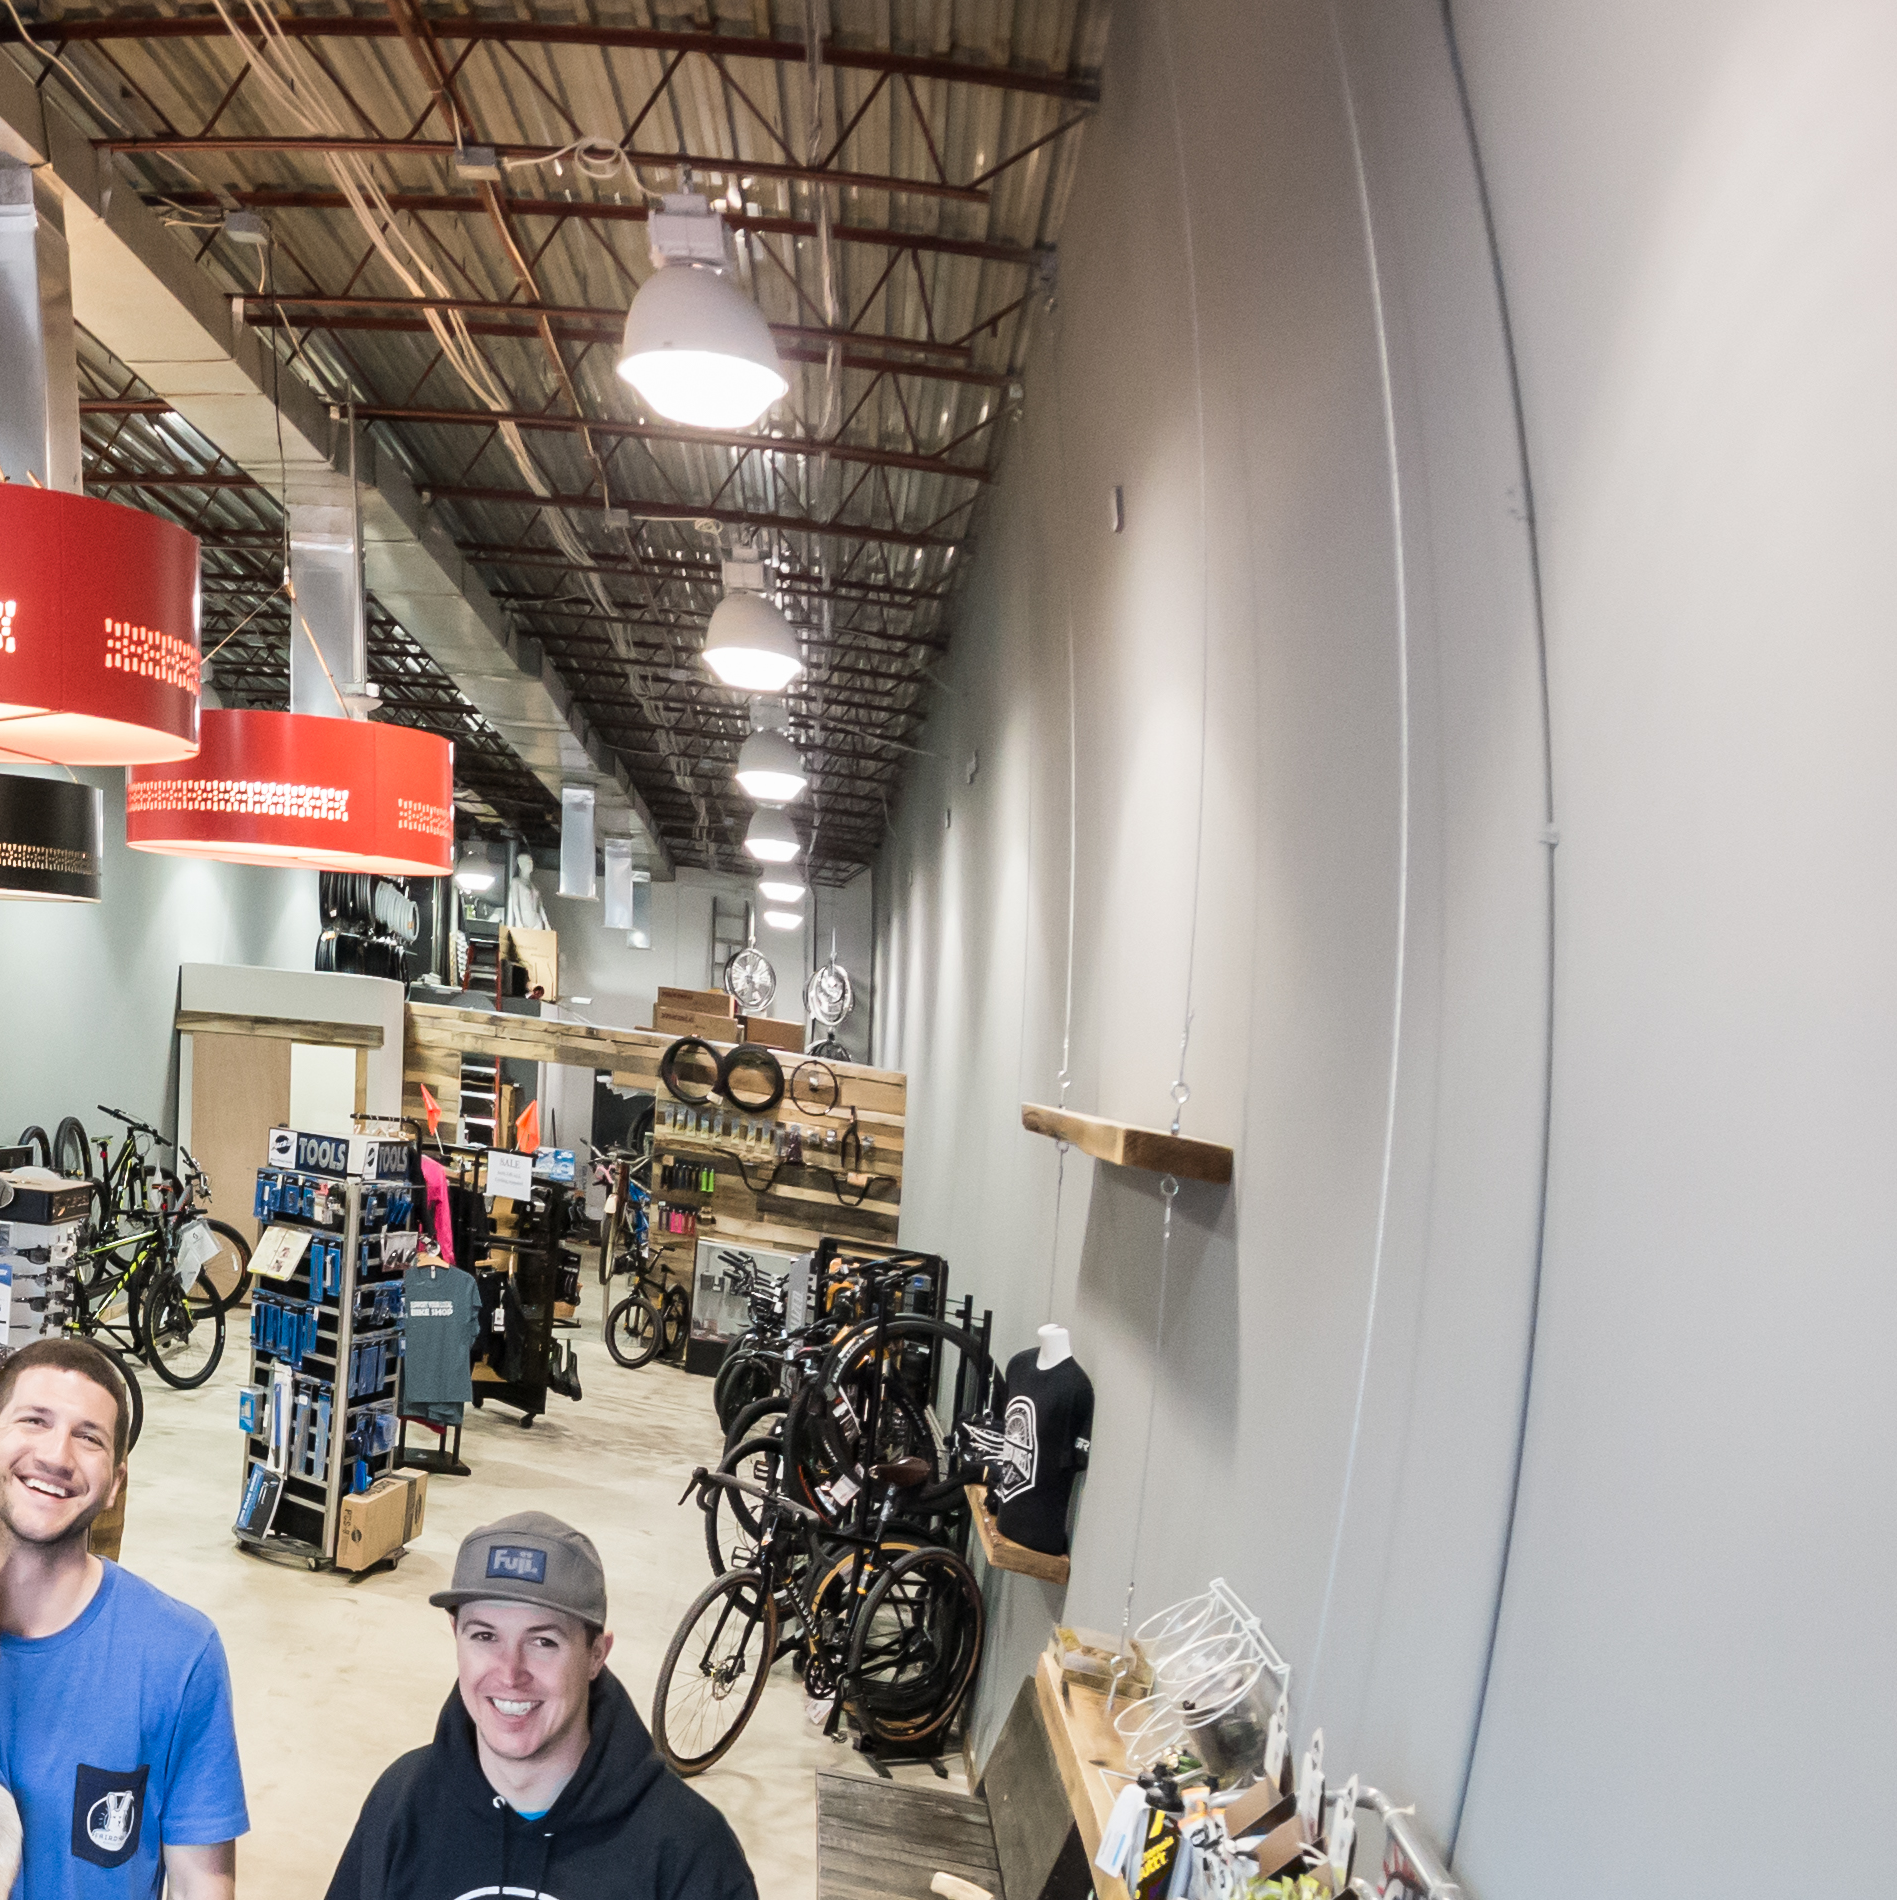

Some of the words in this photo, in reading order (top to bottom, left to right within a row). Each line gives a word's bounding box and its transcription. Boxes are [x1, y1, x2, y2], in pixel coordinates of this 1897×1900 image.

[299, 1137, 346, 1171] TOOLS
[379, 1145, 407, 1171] TOOLS
[500, 1157, 520, 1170] SALE
[410, 1308, 429, 1317] BIKE
[431, 1308, 454, 1317] SHOP
